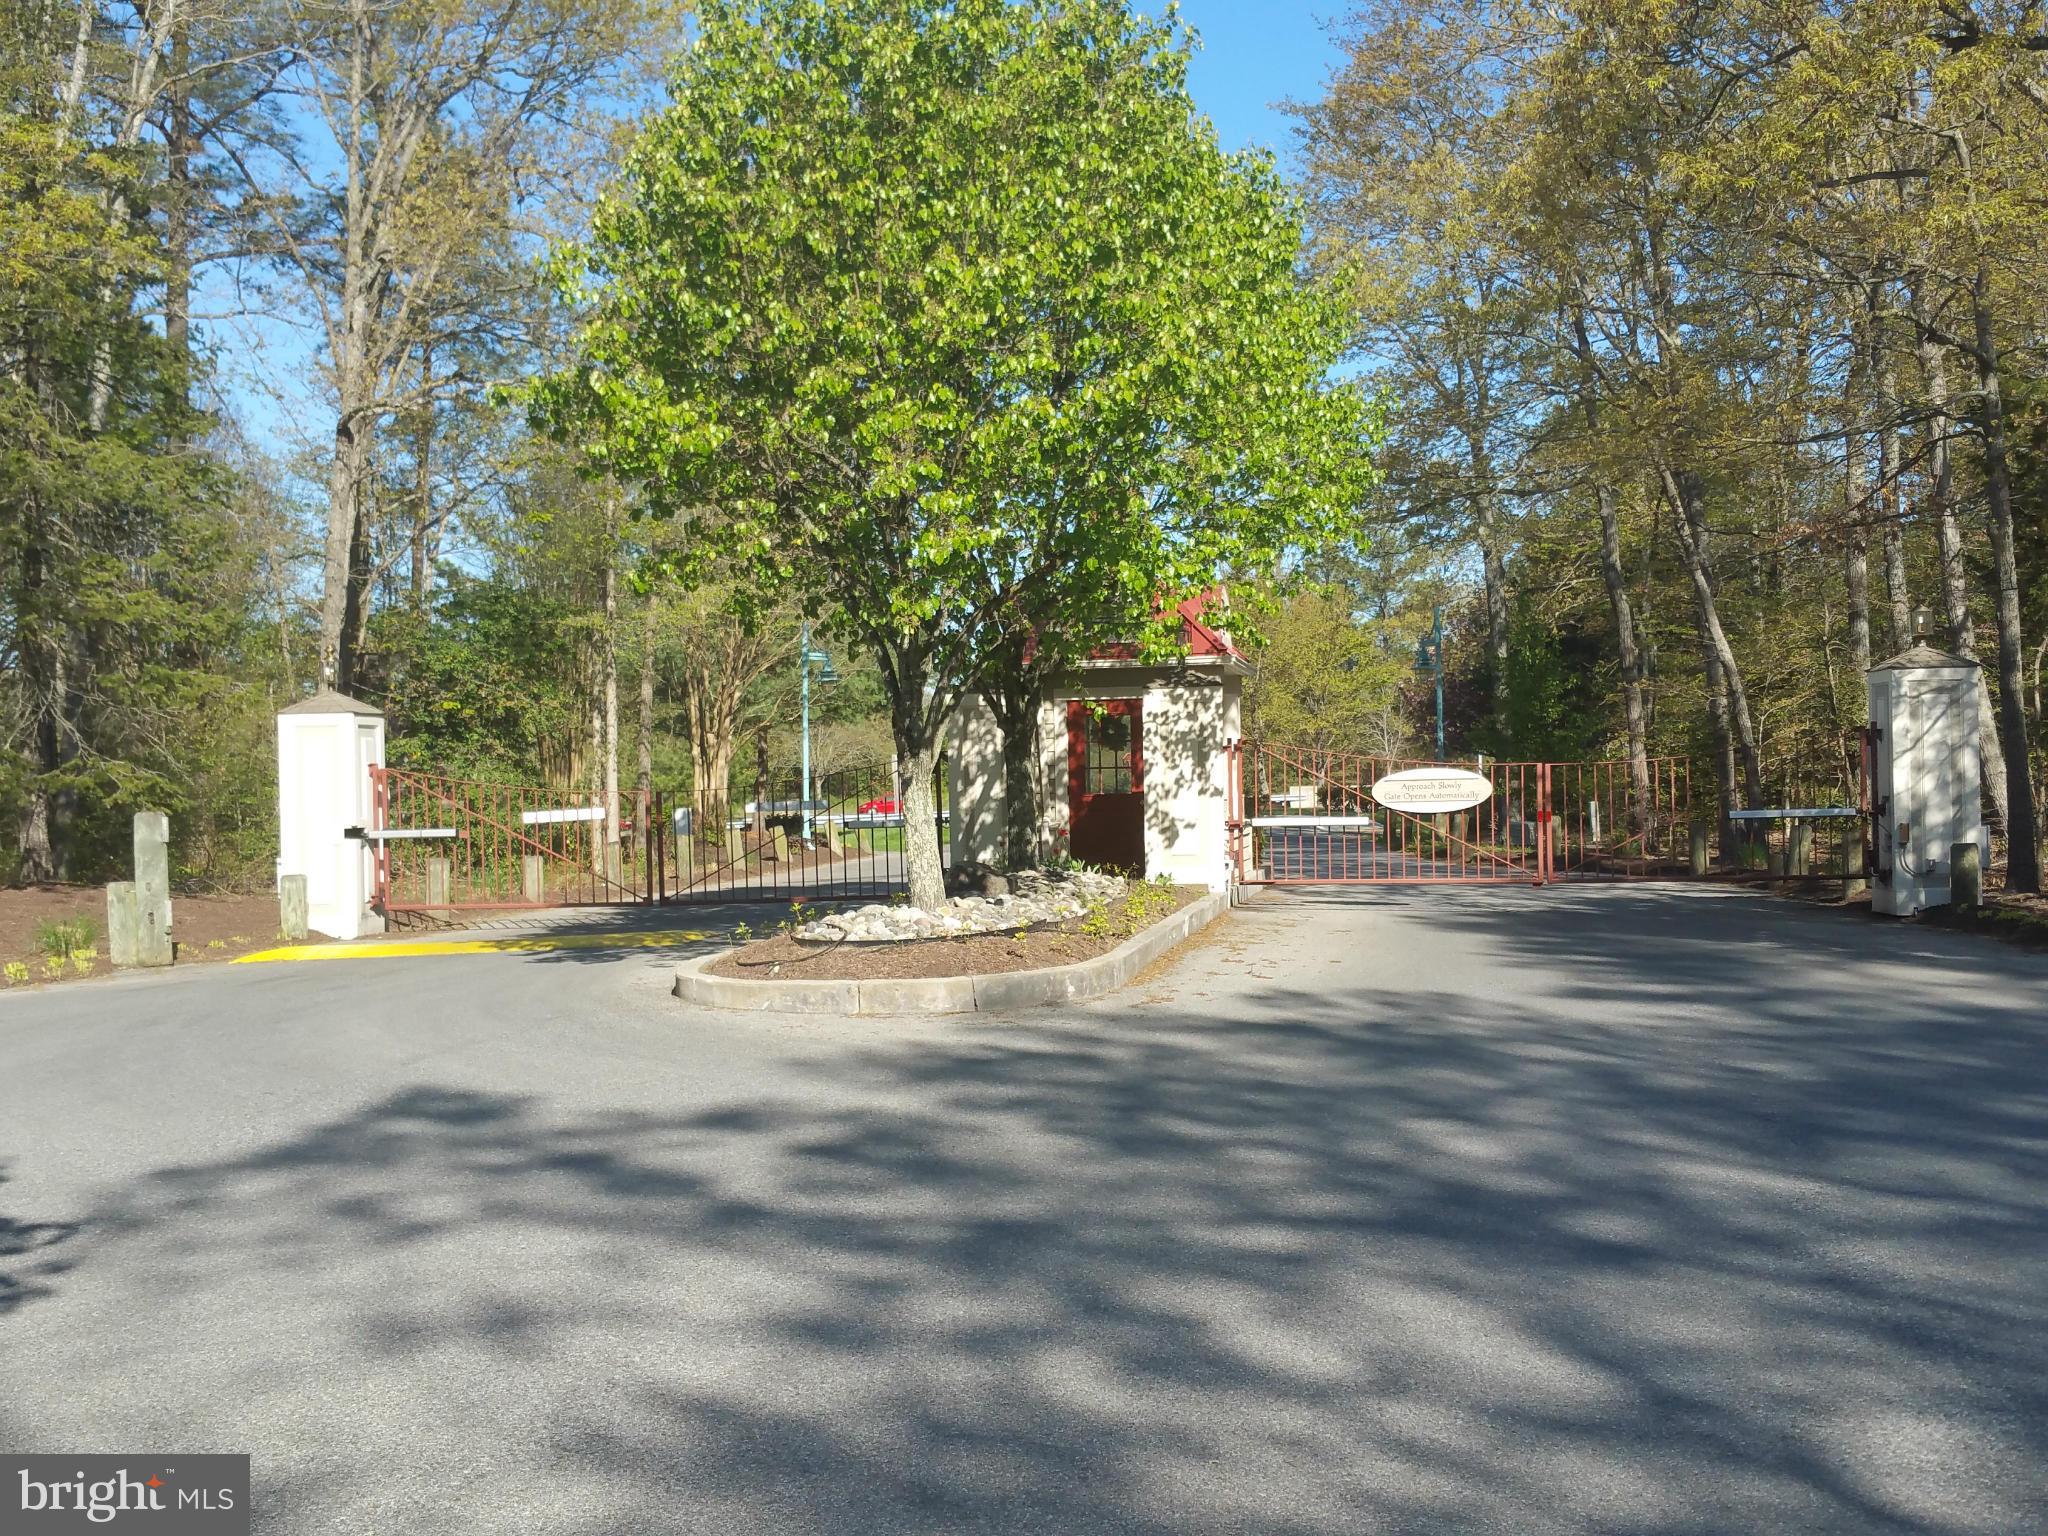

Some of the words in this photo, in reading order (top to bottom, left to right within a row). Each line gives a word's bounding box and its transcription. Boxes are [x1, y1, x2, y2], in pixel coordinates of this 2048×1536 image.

[1401, 783, 1436, 791] Approach
[1438, 782, 1462, 791] Slowly
[1403, 792, 1427, 801] Opens
[1429, 791, 1480, 801] Automatically
